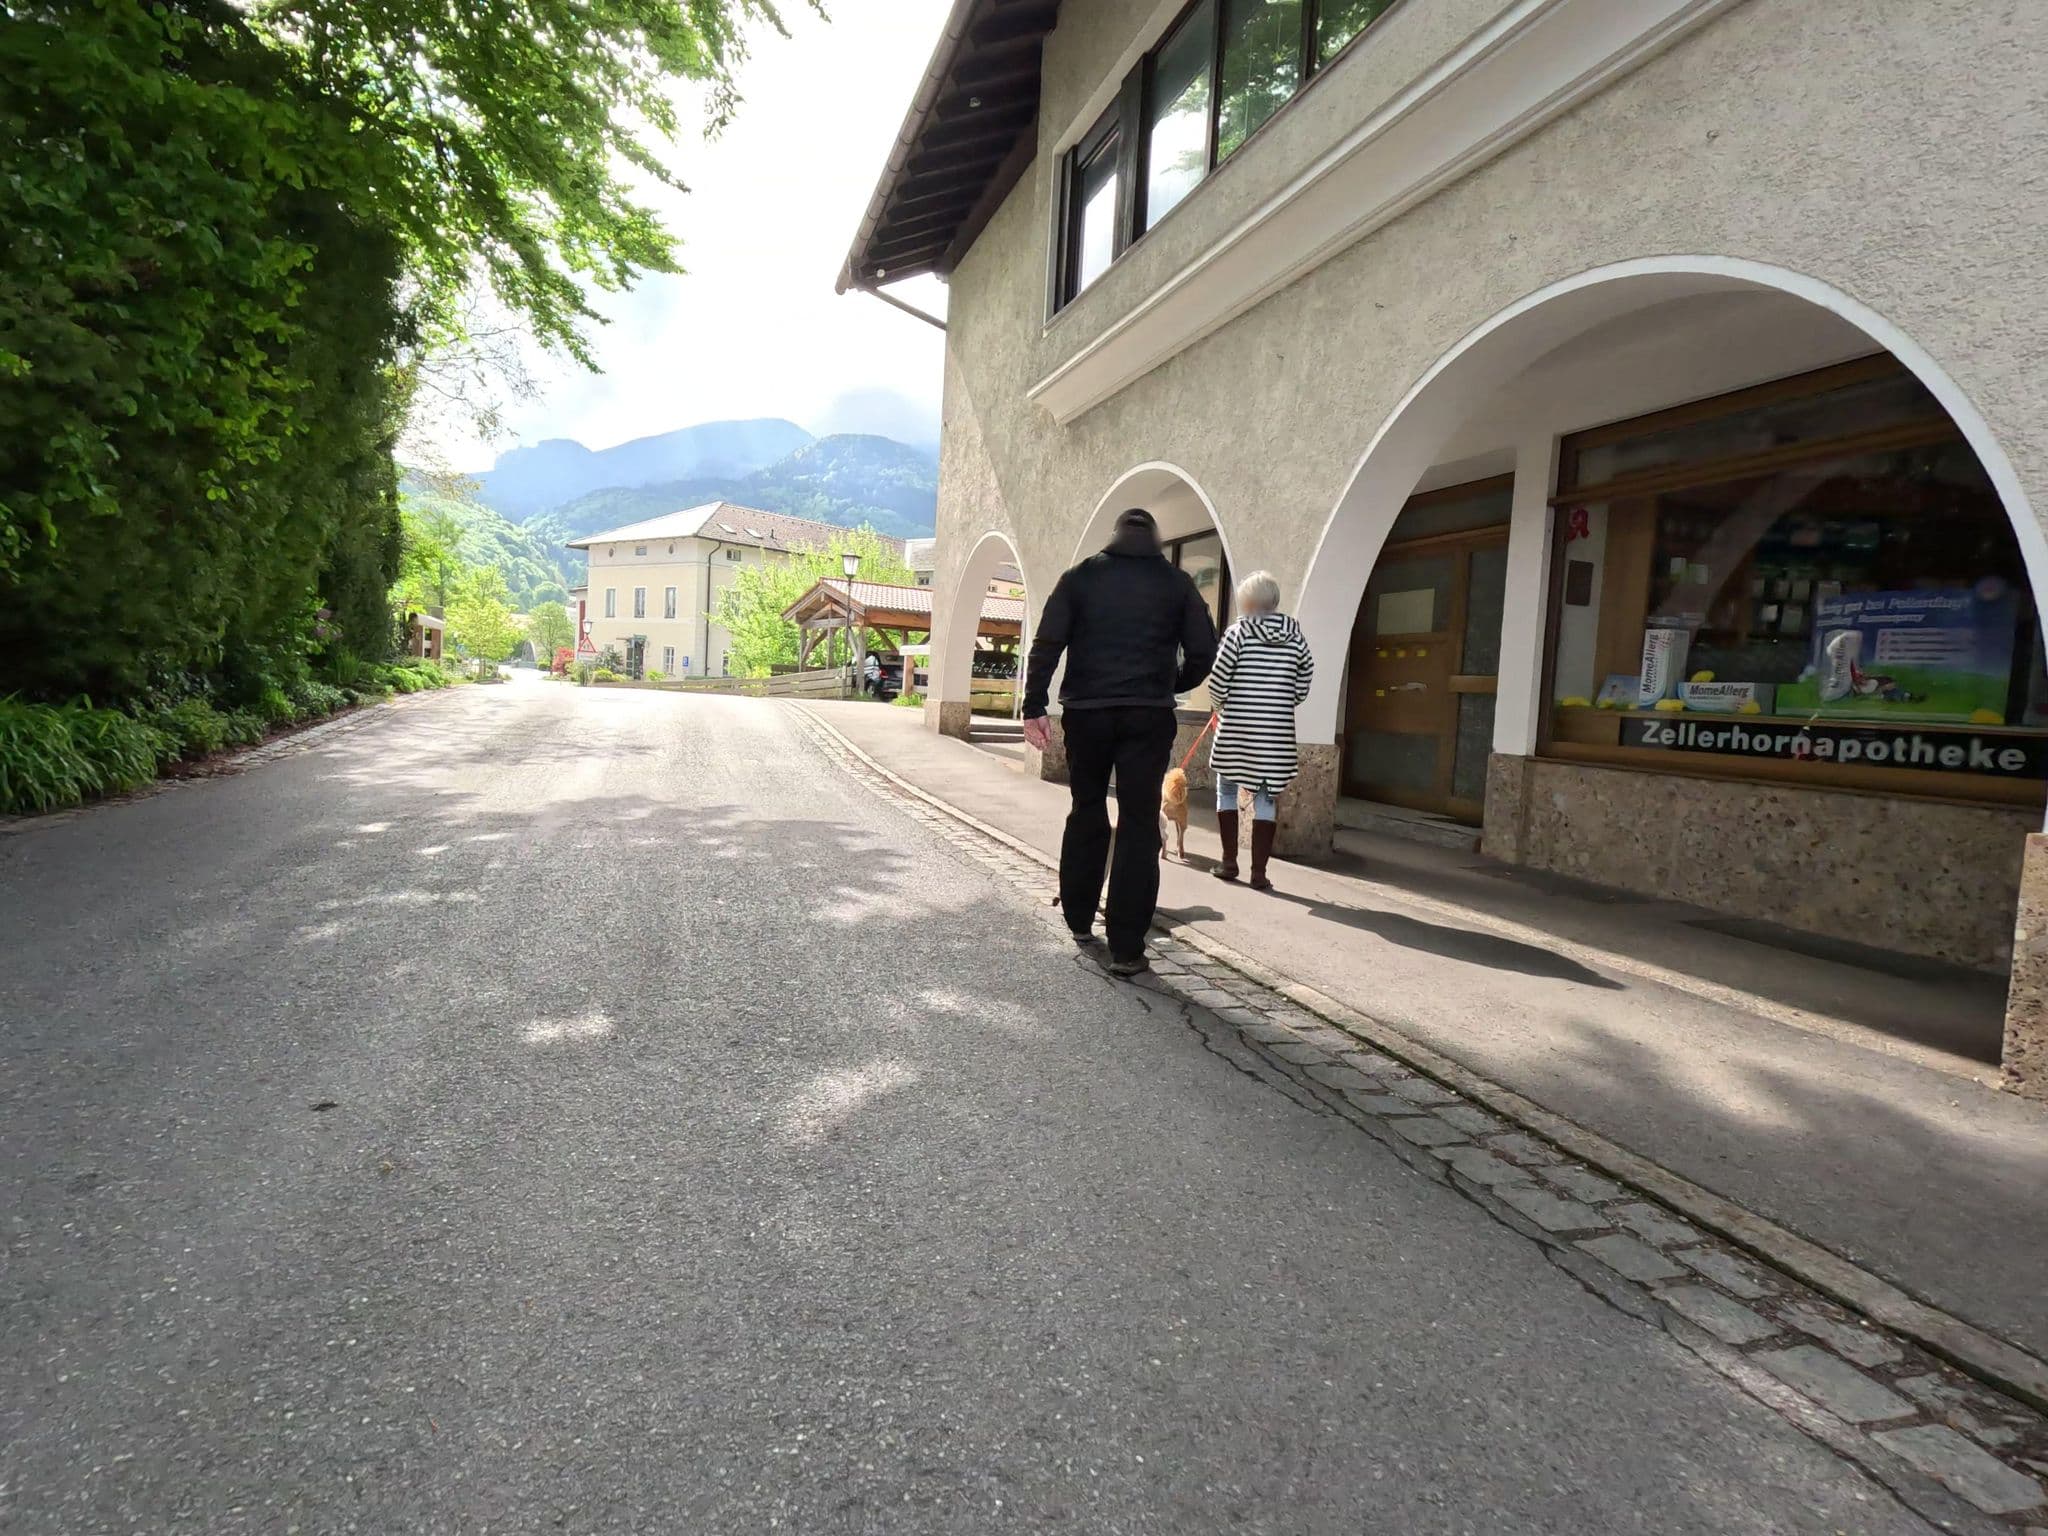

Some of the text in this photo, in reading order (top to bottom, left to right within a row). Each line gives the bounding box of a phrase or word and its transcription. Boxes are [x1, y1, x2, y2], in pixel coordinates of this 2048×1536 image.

[1642, 634, 1659, 693] MomeAllerg
[1689, 684, 1750, 698] MomeAllerg
[1641, 720, 2027, 771] Zellerhornapotheke
